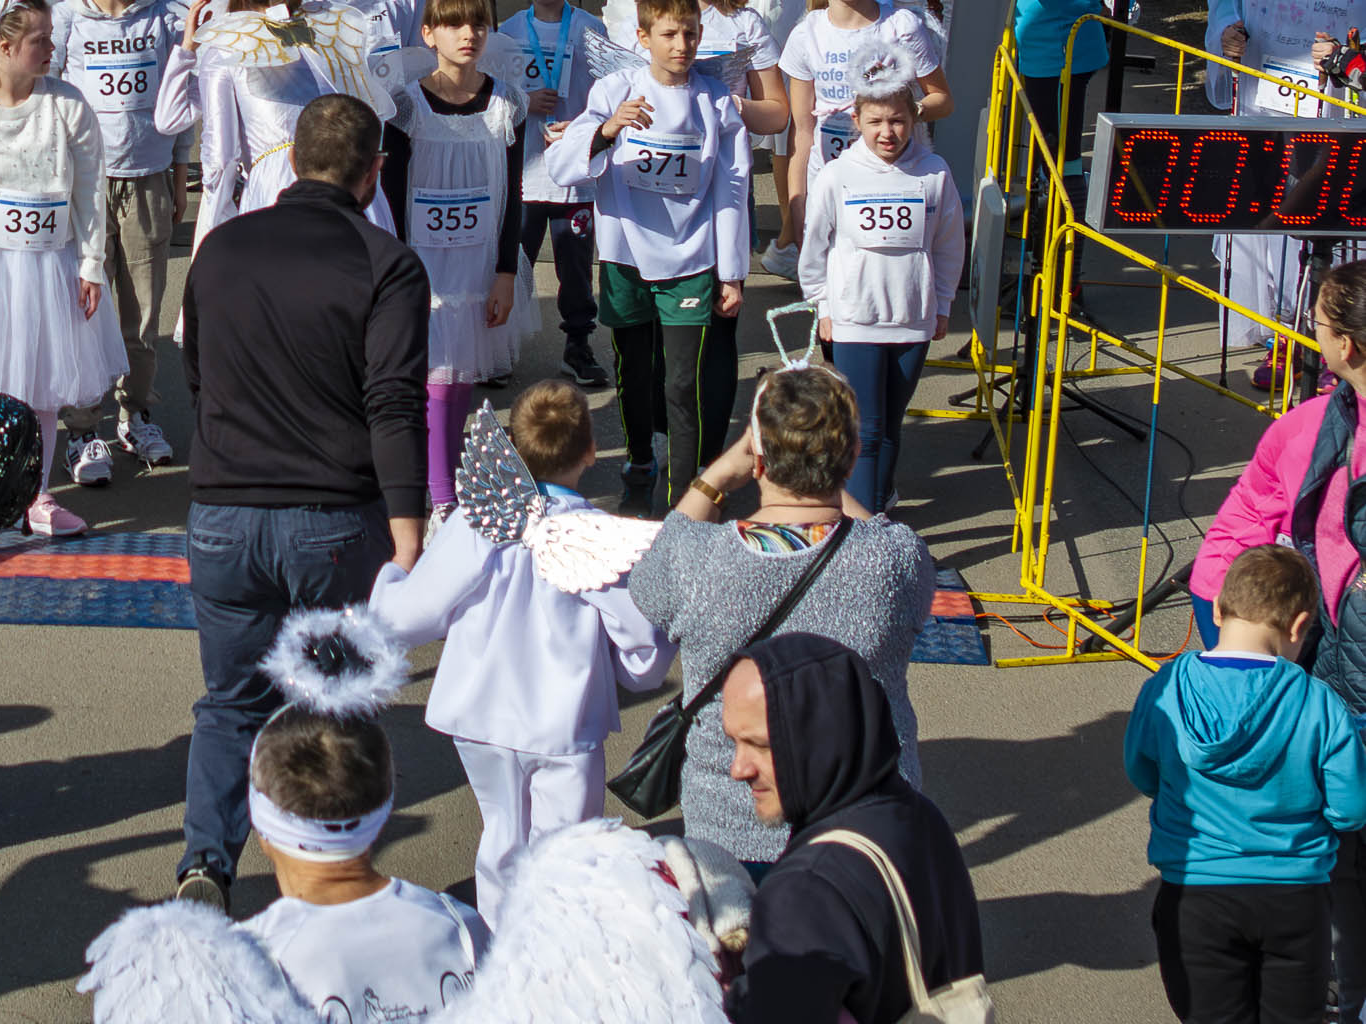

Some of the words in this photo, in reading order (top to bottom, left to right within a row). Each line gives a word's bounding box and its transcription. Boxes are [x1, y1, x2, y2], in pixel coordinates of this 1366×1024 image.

[84, 34, 155, 55] SERIO?
[98, 70, 148, 96] 368
[636, 149, 688, 177] 371
[5, 208, 57, 234] 334
[426, 205, 478, 231] 355
[859, 206, 913, 231] 358
